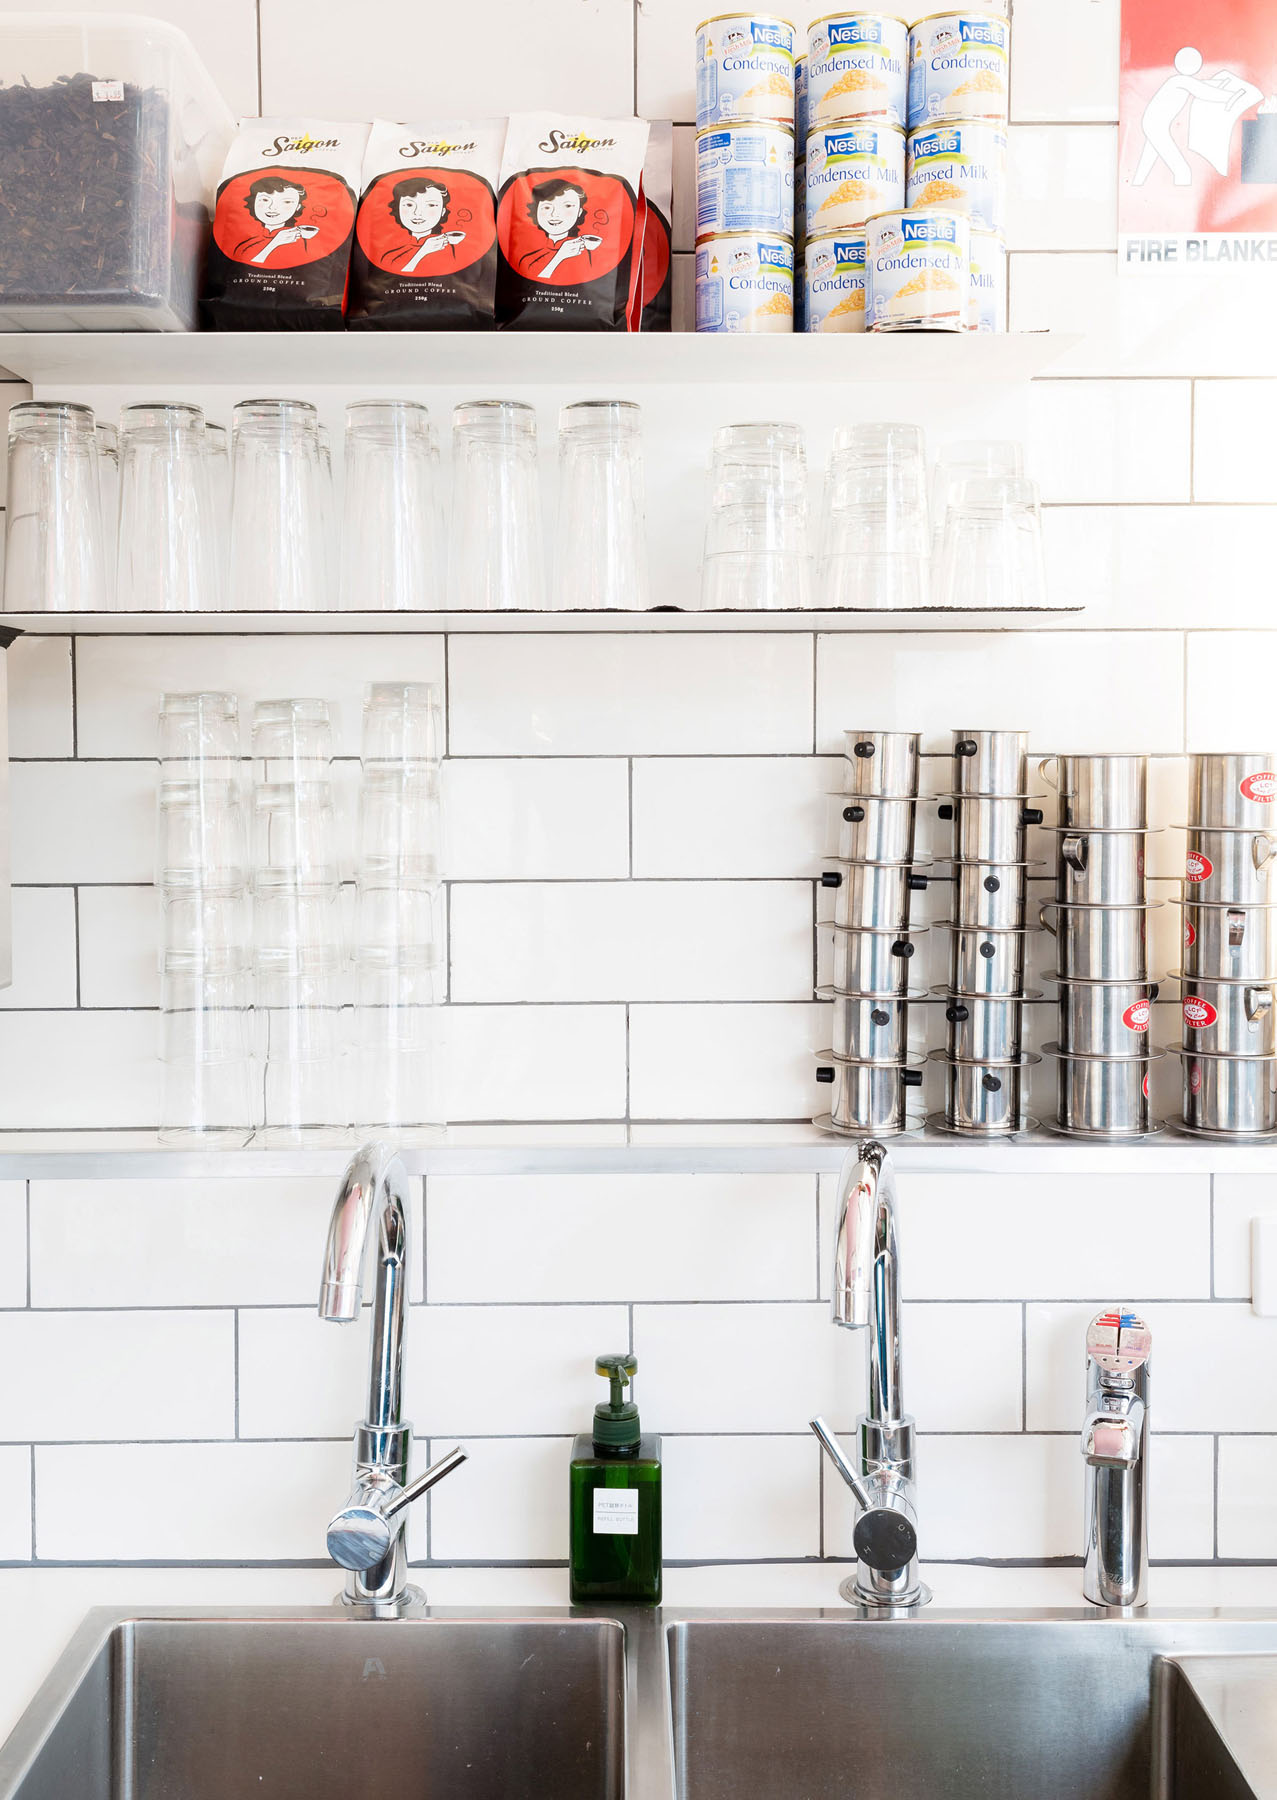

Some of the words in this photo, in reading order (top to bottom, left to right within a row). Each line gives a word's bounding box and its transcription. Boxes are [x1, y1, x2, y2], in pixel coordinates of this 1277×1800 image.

[723, 56, 790, 77] Condensed
[810, 55, 875, 79] Condensed
[931, 54, 1000, 73] Condensed
[262, 136, 342, 157] Saigon
[399, 141, 478, 158] Saigon
[538, 130, 616, 153] Saigon
[807, 165, 870, 188] Condensed
[877, 168, 900, 184] Milk
[908, 164, 953, 187] ndensed
[960, 165, 988, 180] Milk
[837, 247, 865, 261] Nes
[1126, 240, 1178, 261] FIRE
[1186, 240, 1277, 261] BLANKE
[876, 254, 950, 272] Condensed
[730, 275, 792, 296] Condensed
[812, 274, 865, 293] Condens
[970, 273, 995, 288] Milk
[560, 298, 593, 306] COFFEE
[1250, 773, 1277, 783] COFFE
